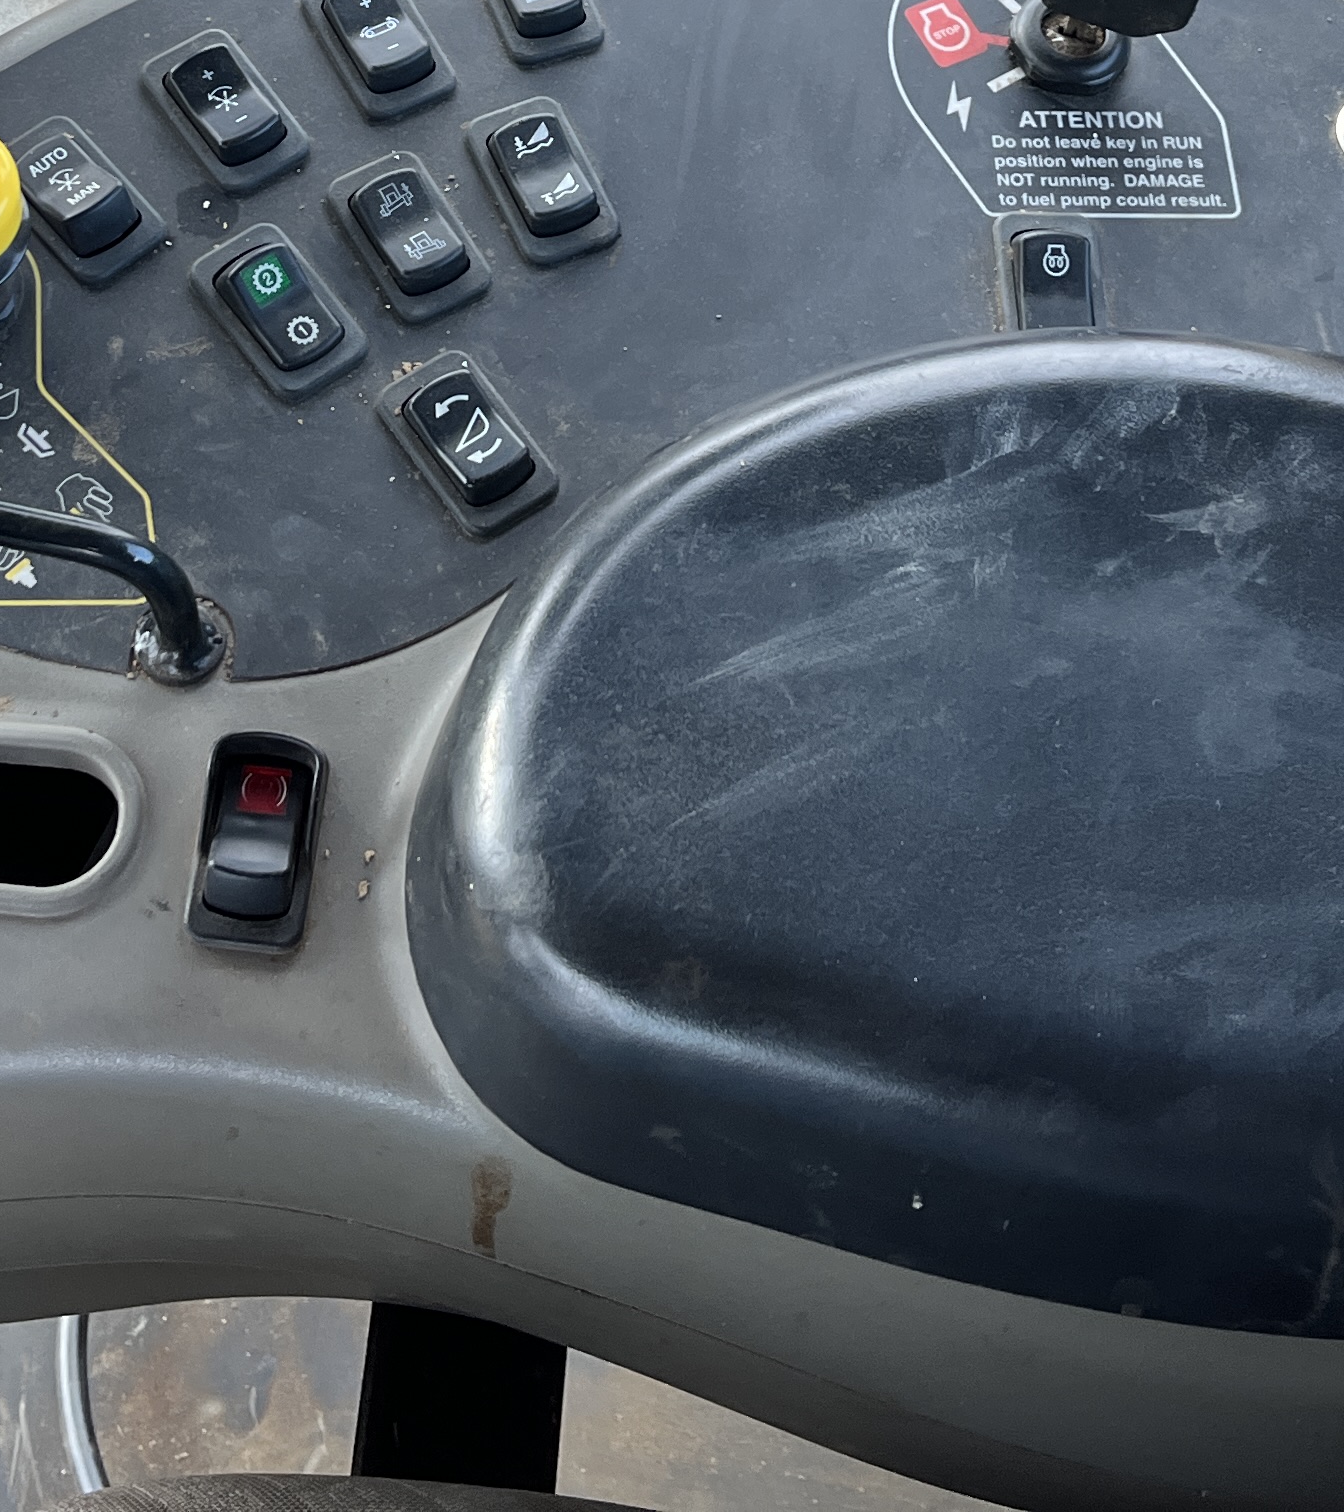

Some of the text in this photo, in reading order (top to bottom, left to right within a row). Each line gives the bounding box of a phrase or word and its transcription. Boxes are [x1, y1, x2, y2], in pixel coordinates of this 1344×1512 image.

[933, 24, 961, 40] STOP
[1019, 110, 1164, 129] ATTENTION
[991, 134, 1203, 153] Do not leave key in RUN
[28, 147, 68, 178] AUTO
[994, 154, 1204, 172] position when engine is
[996, 172, 1206, 190] NOT running. DAMAGE
[66, 181, 101, 206] MAN
[998, 192, 1227, 209] to fuel pump could result.
[262, 272, 274, 286] 2
[298, 324, 309, 336] 1
